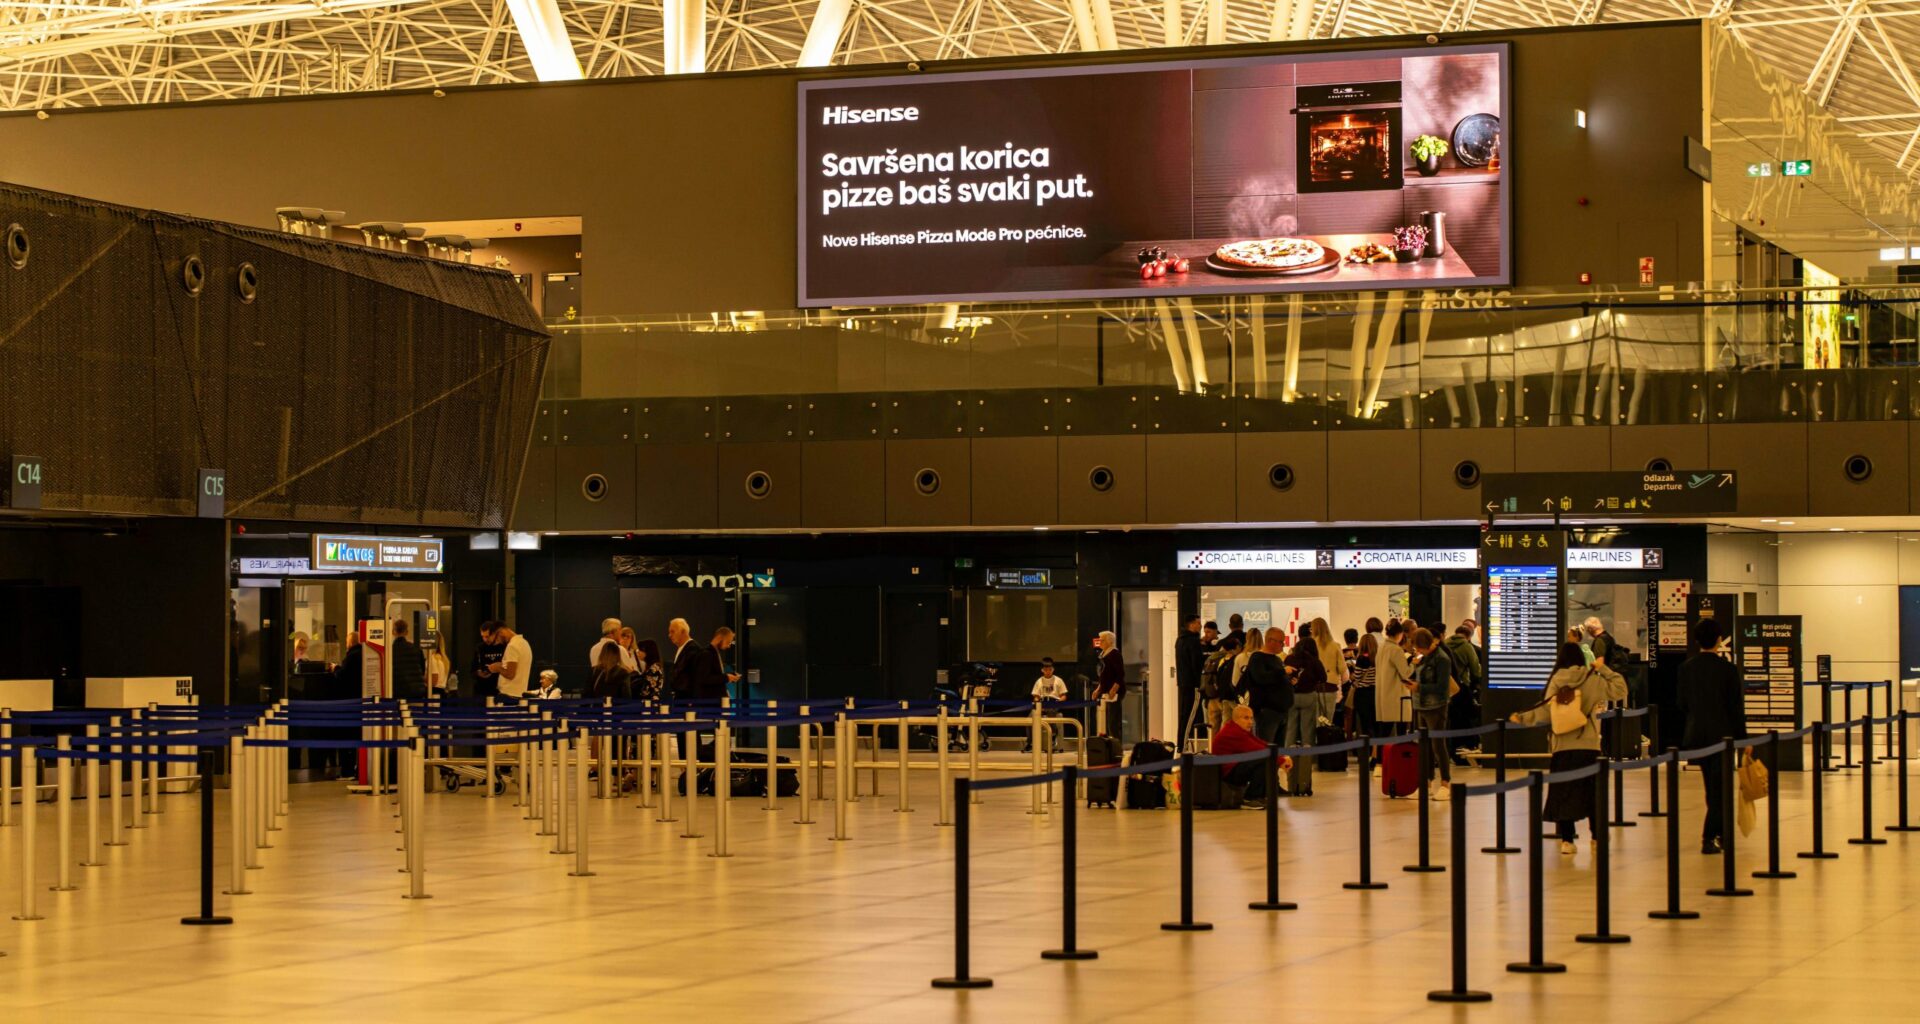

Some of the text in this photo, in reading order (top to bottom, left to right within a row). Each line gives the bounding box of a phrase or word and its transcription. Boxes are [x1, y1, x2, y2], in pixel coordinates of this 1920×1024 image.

[822, 105, 919, 125] Hisense
[822, 142, 1050, 177] Savršena korica
[822, 173, 1094, 215] pizze baš svaki put.
[822, 225, 1087, 248] Nove Hisense Pizza Mode Pro pećnice.
[17, 463, 41, 484] C14
[1643, 474, 1675, 482] Odlazak
[204, 476, 224, 496] C15
[1643, 483, 1682, 491] Departure
[1205, 552, 1305, 564] CROATIA AIRLINES
[1364, 551, 1467, 563] CROATIA AIRLINES
[1579, 550, 1632, 563] AIRLINES
[1243, 610, 1270, 621] A220
[1649, 593, 1657, 669] STAR ALLIANCE
